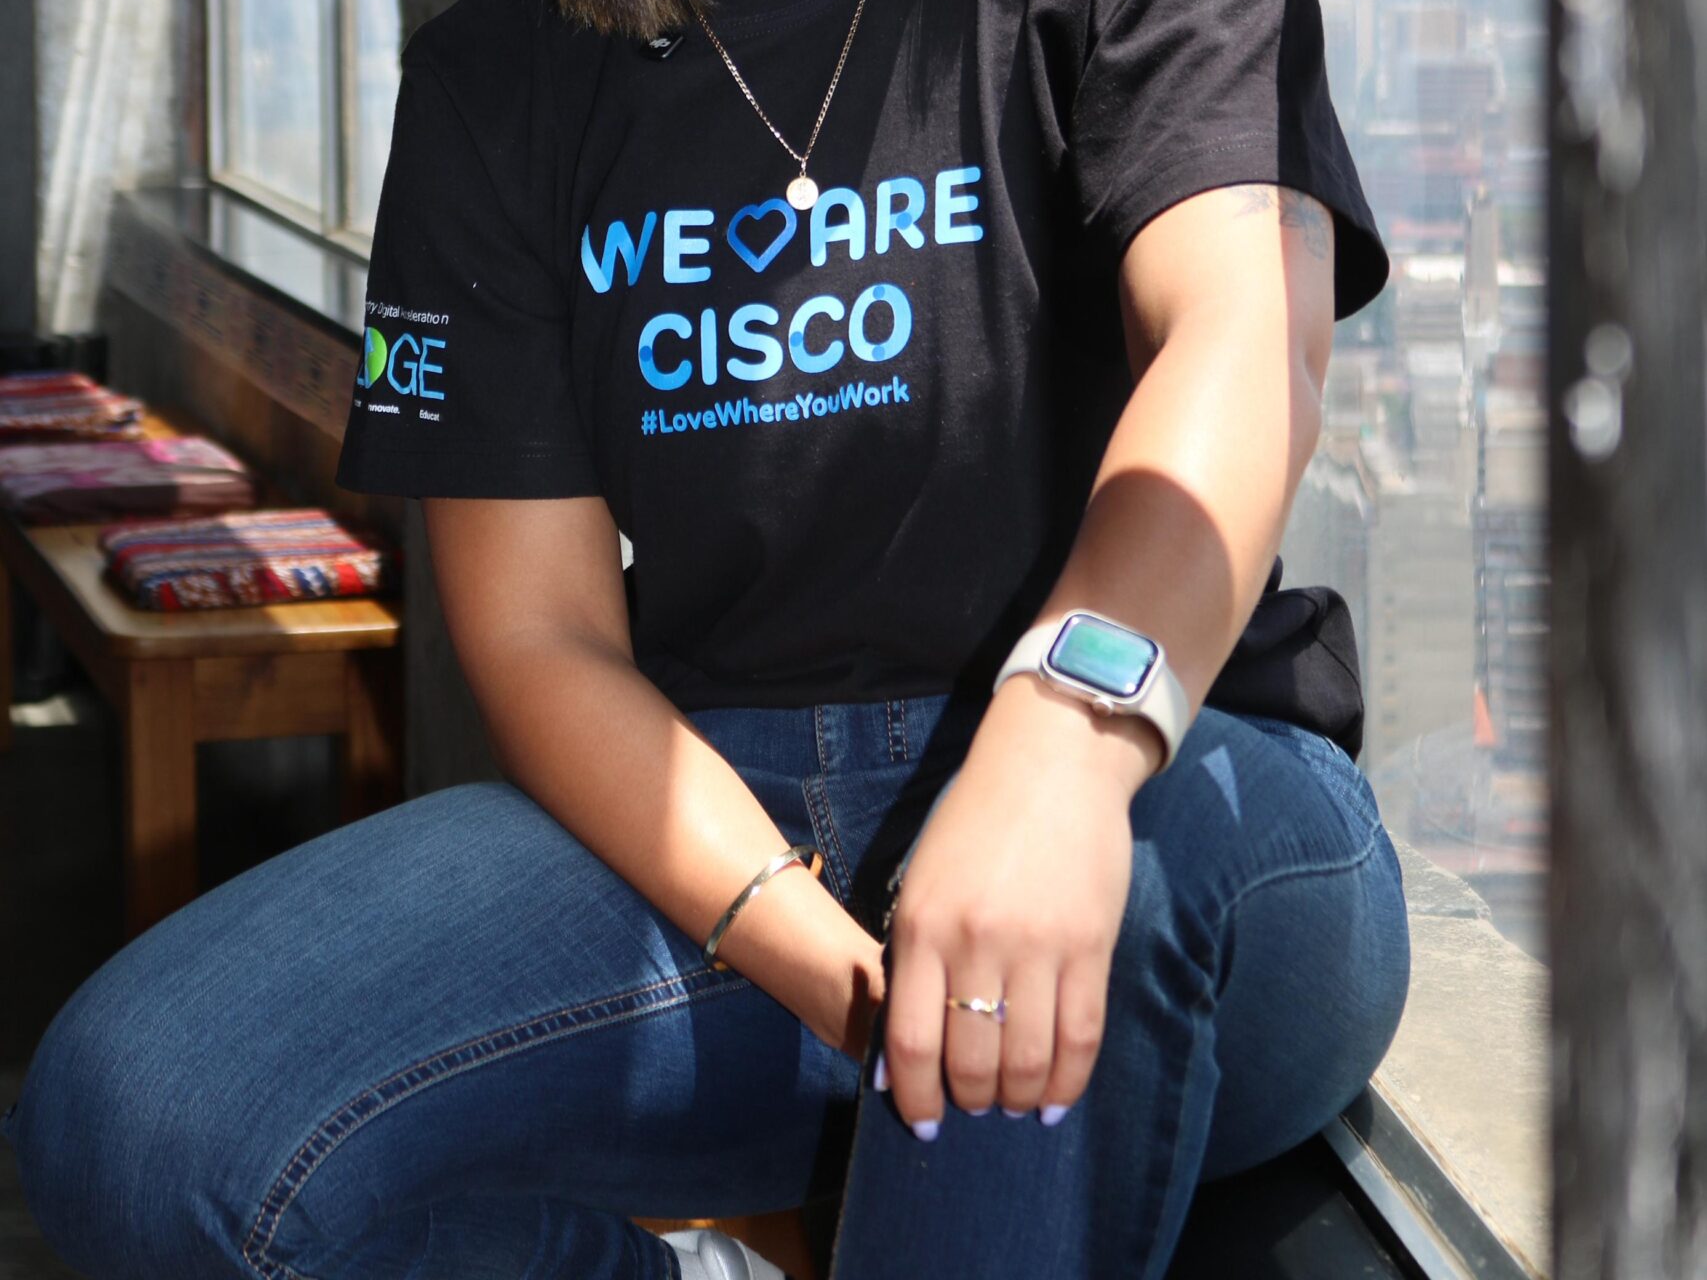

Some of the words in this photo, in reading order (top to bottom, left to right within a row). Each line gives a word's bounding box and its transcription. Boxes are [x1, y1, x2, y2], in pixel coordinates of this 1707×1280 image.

[580, 209, 715, 293] WE
[809, 166, 984, 267] ARE
[637, 283, 913, 391] CISCO
[368, 403, 400, 414] nnovate.
[641, 376, 910, 435] #LoveWhereYouWork
